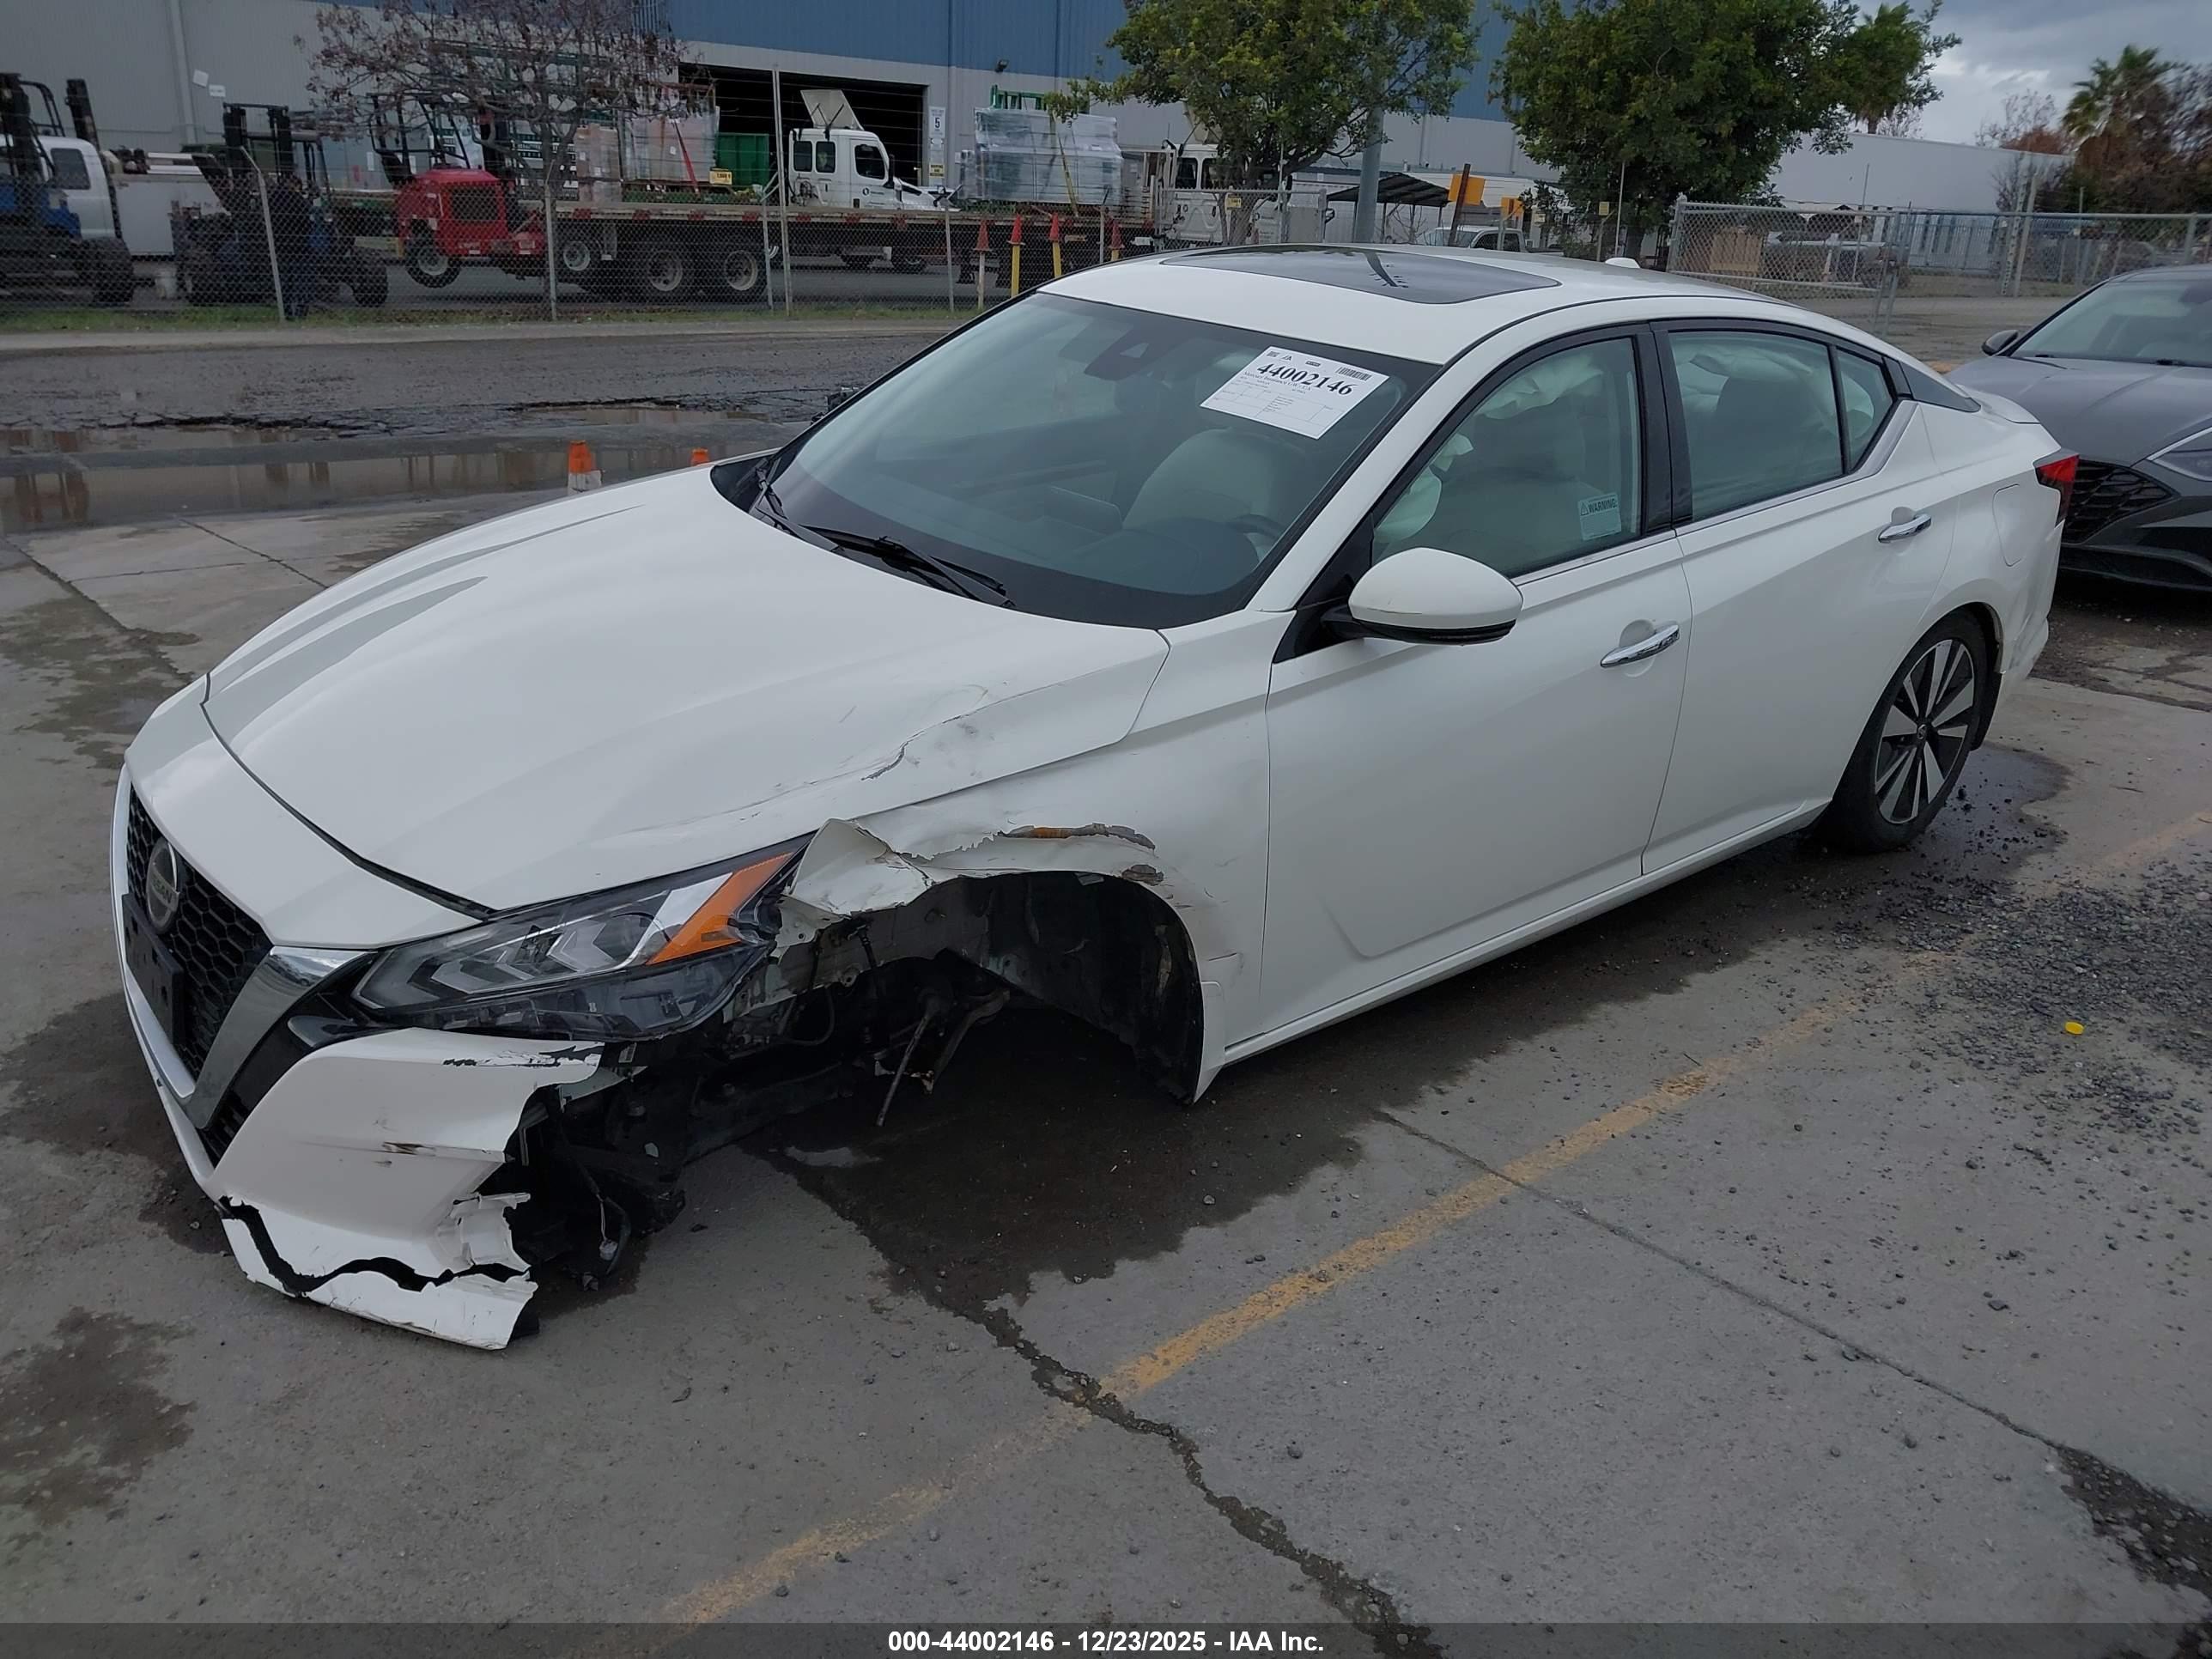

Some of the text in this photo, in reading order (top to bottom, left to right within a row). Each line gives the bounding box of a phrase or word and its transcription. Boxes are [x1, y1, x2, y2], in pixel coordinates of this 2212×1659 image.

[935, 117, 941, 128] 5
[1256, 362, 1358, 396] 44002146
[1588, 498, 1617, 514] WARNING
